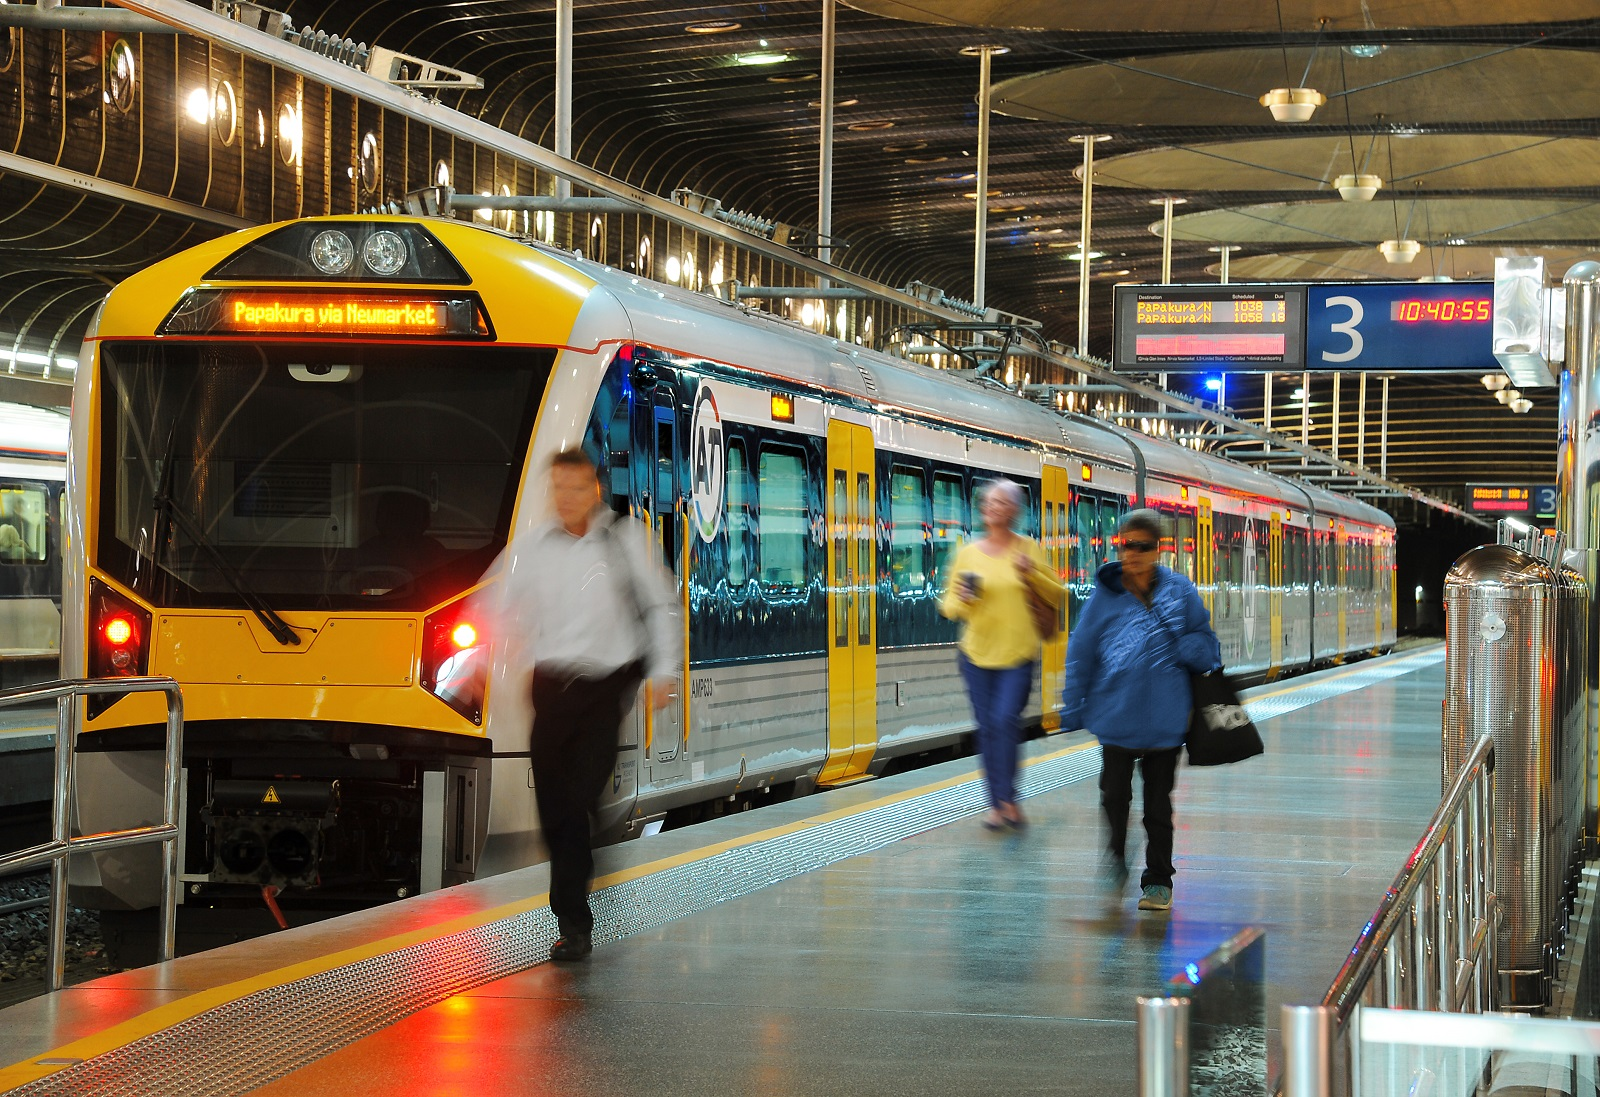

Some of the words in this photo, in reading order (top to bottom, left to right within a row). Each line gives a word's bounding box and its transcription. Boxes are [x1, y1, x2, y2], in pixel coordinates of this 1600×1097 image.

[234, 301, 315, 324] Papakura
[318, 303, 343, 324] via
[346, 303, 435, 325] Newmarket
[1137, 301, 1212, 313] Papakura/N
[1234, 301, 1263, 312] 1038
[1137, 313, 1212, 324] Papakura/N
[1234, 313, 1263, 323] 1058
[1271, 312, 1286, 323] 18
[1399, 300, 1490, 321] 10:40:55
[1321, 295, 1364, 363] 3
[693, 425, 721, 496] AT
[1540, 488, 1556, 513] 3
